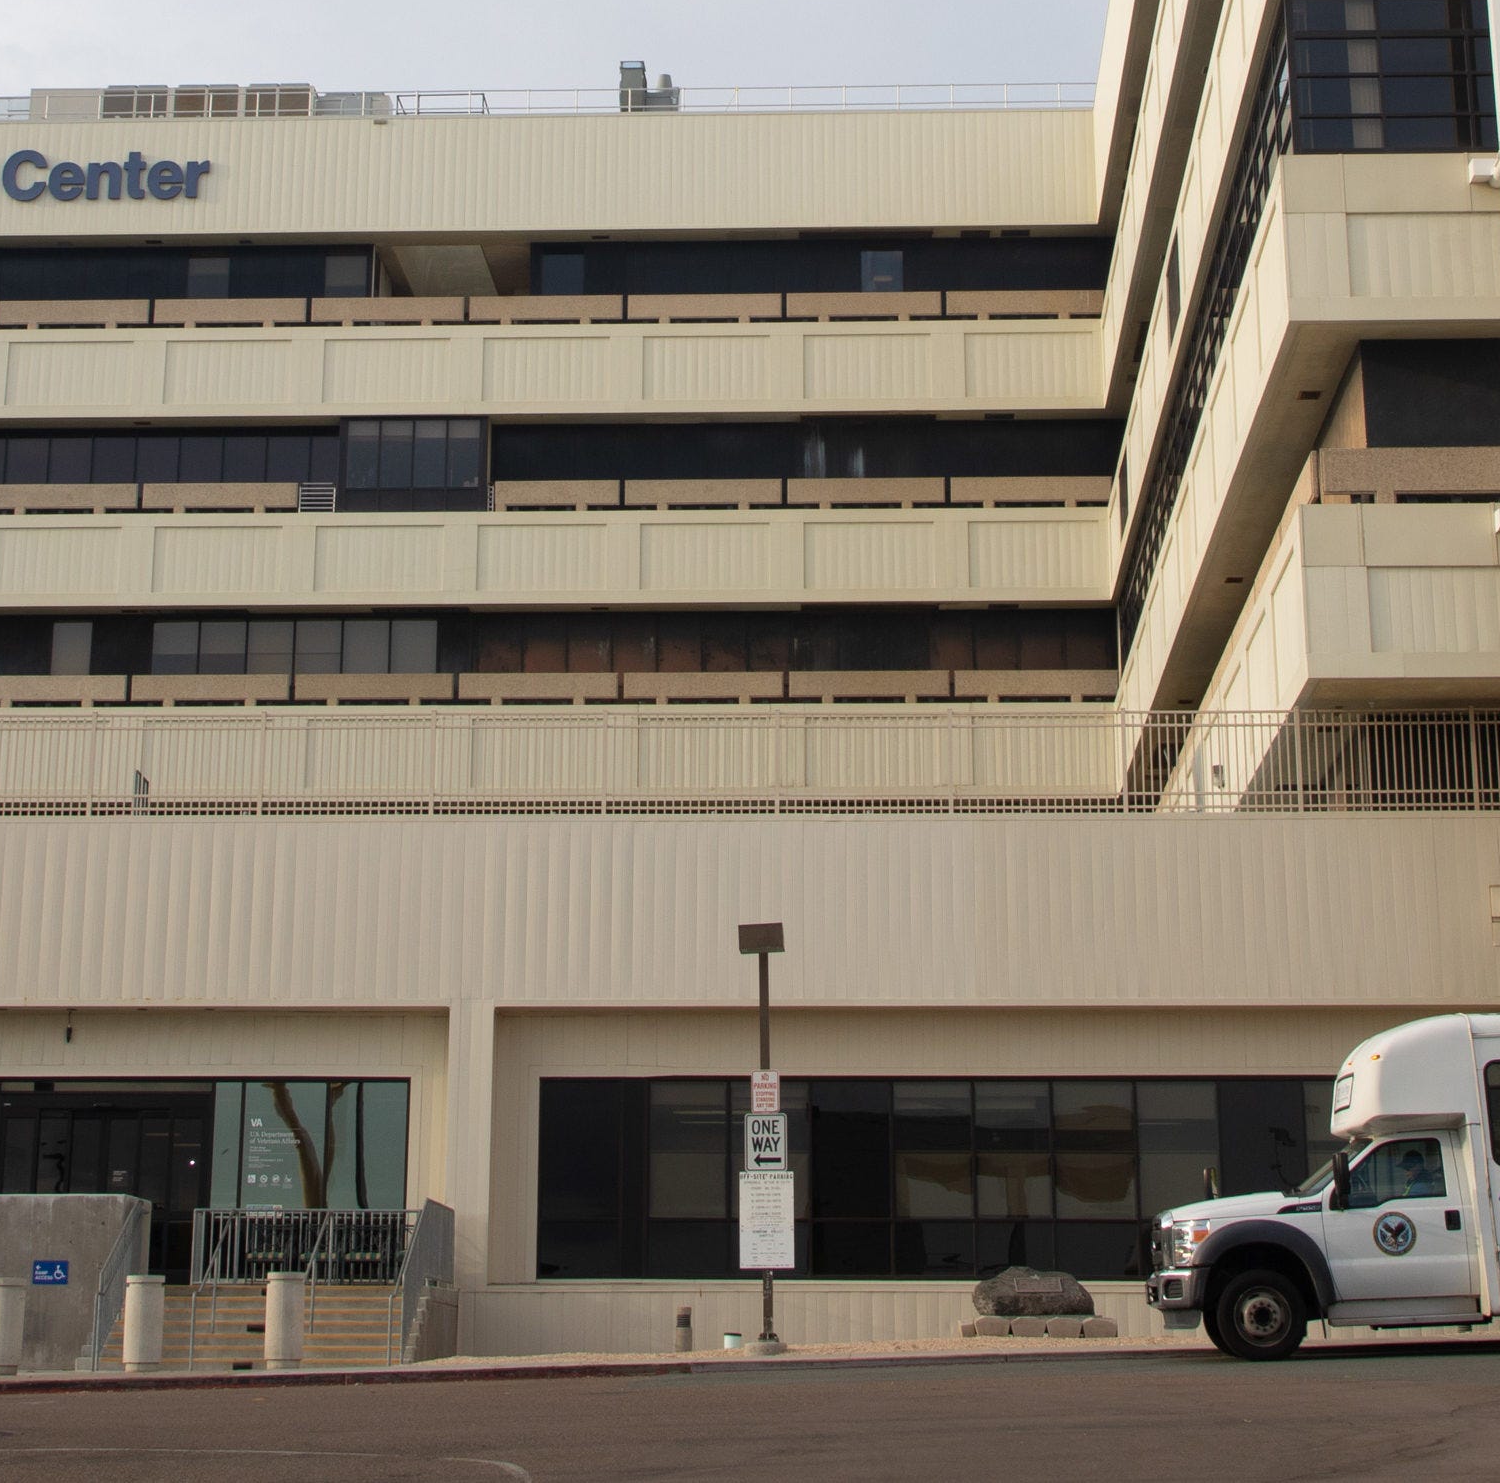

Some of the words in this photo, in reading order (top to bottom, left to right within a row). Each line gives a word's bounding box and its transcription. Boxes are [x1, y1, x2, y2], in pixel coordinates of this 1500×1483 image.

[2, 149, 211, 203] Center
[761, 1073, 769, 1081] NO
[250, 1118, 263, 1127] VA
[752, 1119, 780, 1134] ONE
[751, 1137, 780, 1152] WAY
